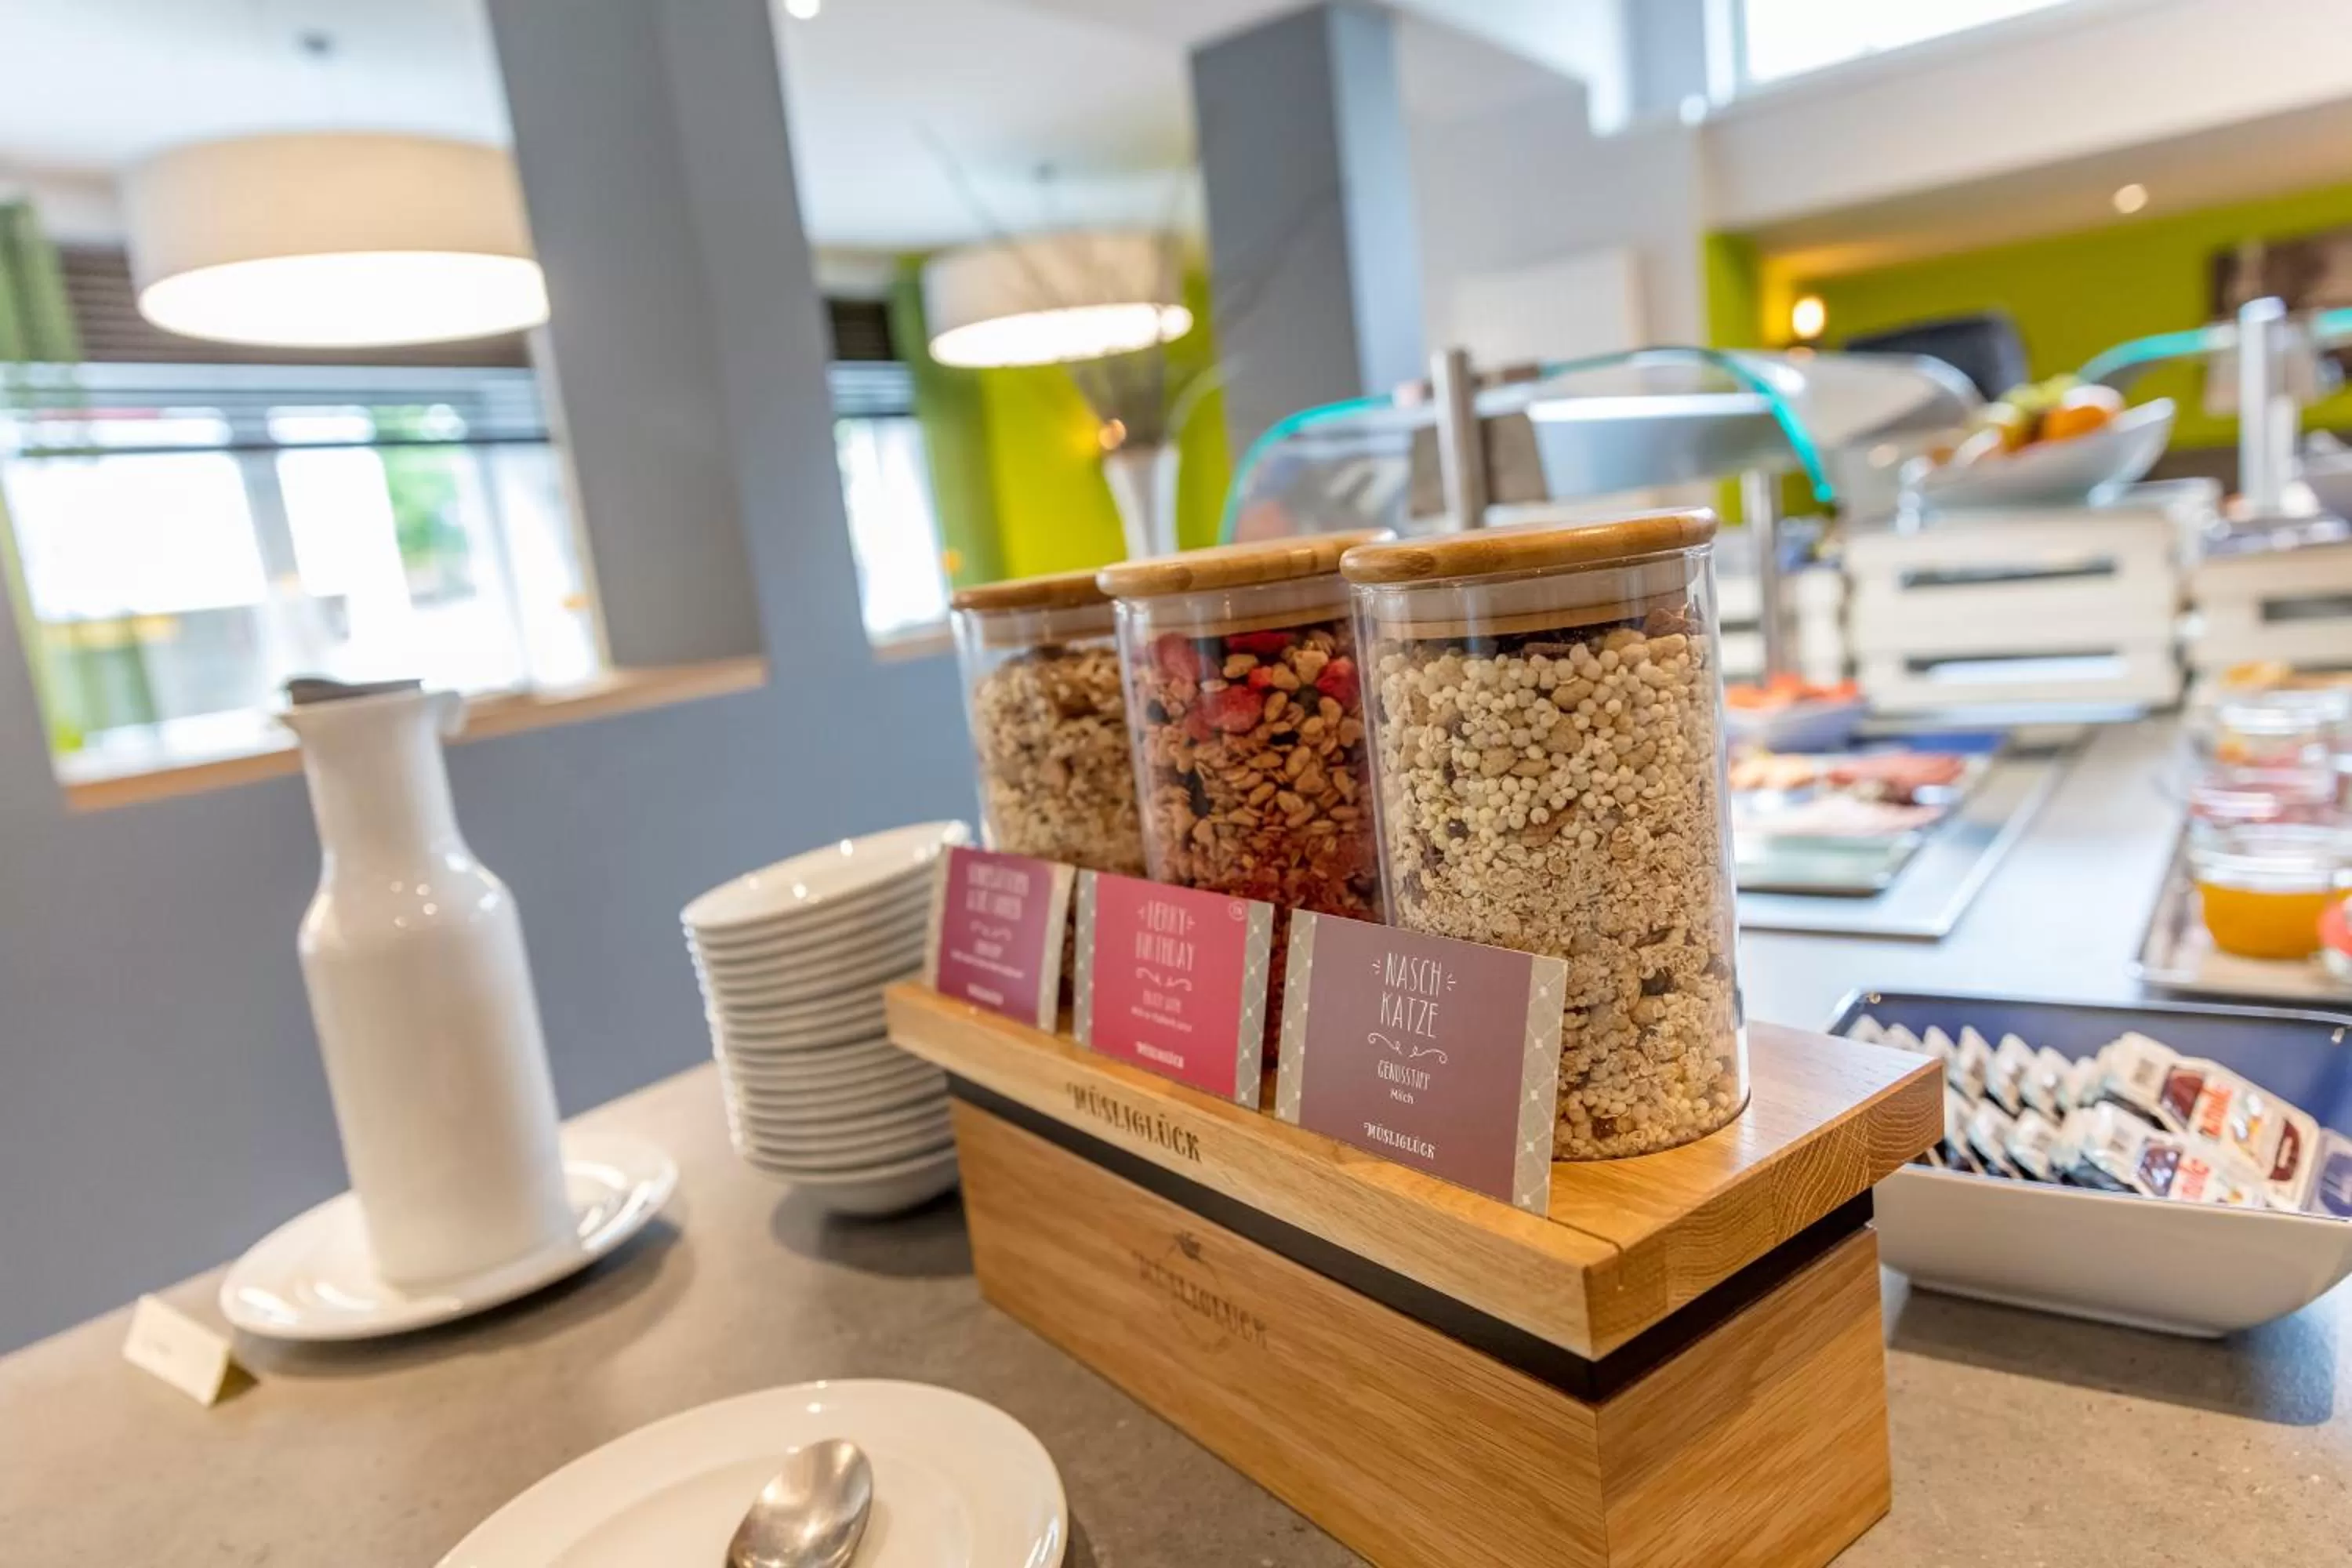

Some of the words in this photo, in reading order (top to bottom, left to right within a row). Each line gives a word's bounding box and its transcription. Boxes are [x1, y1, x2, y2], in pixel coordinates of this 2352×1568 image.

[1385, 952, 1443, 998] NASCH
[1379, 991, 1439, 1039] KATZE
[1065, 1082, 1202, 1163] MÜSLIGLÜCK
[1364, 1122, 1436, 1160] MÜSLIGLÜCK
